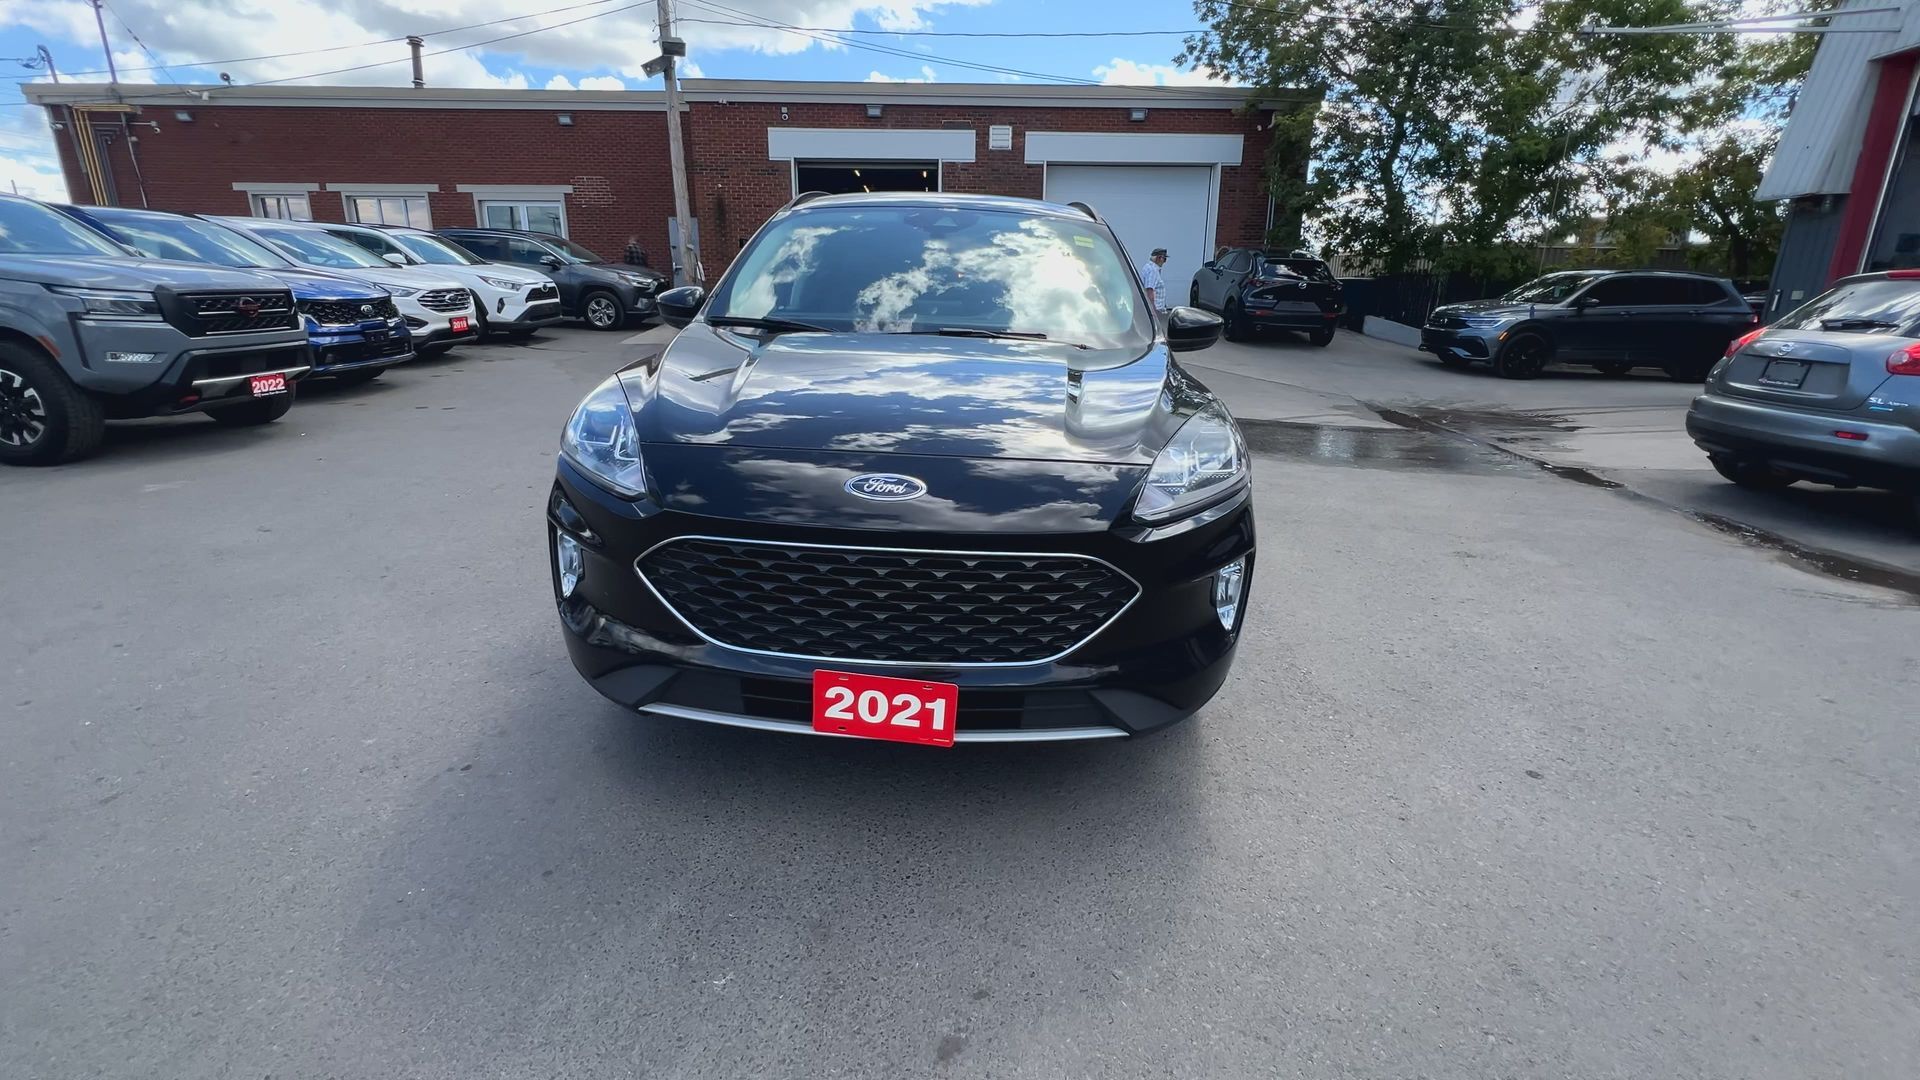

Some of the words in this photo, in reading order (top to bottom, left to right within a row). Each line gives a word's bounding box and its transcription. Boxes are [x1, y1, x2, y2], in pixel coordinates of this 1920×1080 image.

[252, 378, 286, 393] 2022
[863, 477, 908, 494] Ford
[824, 686, 946, 731] 2021
